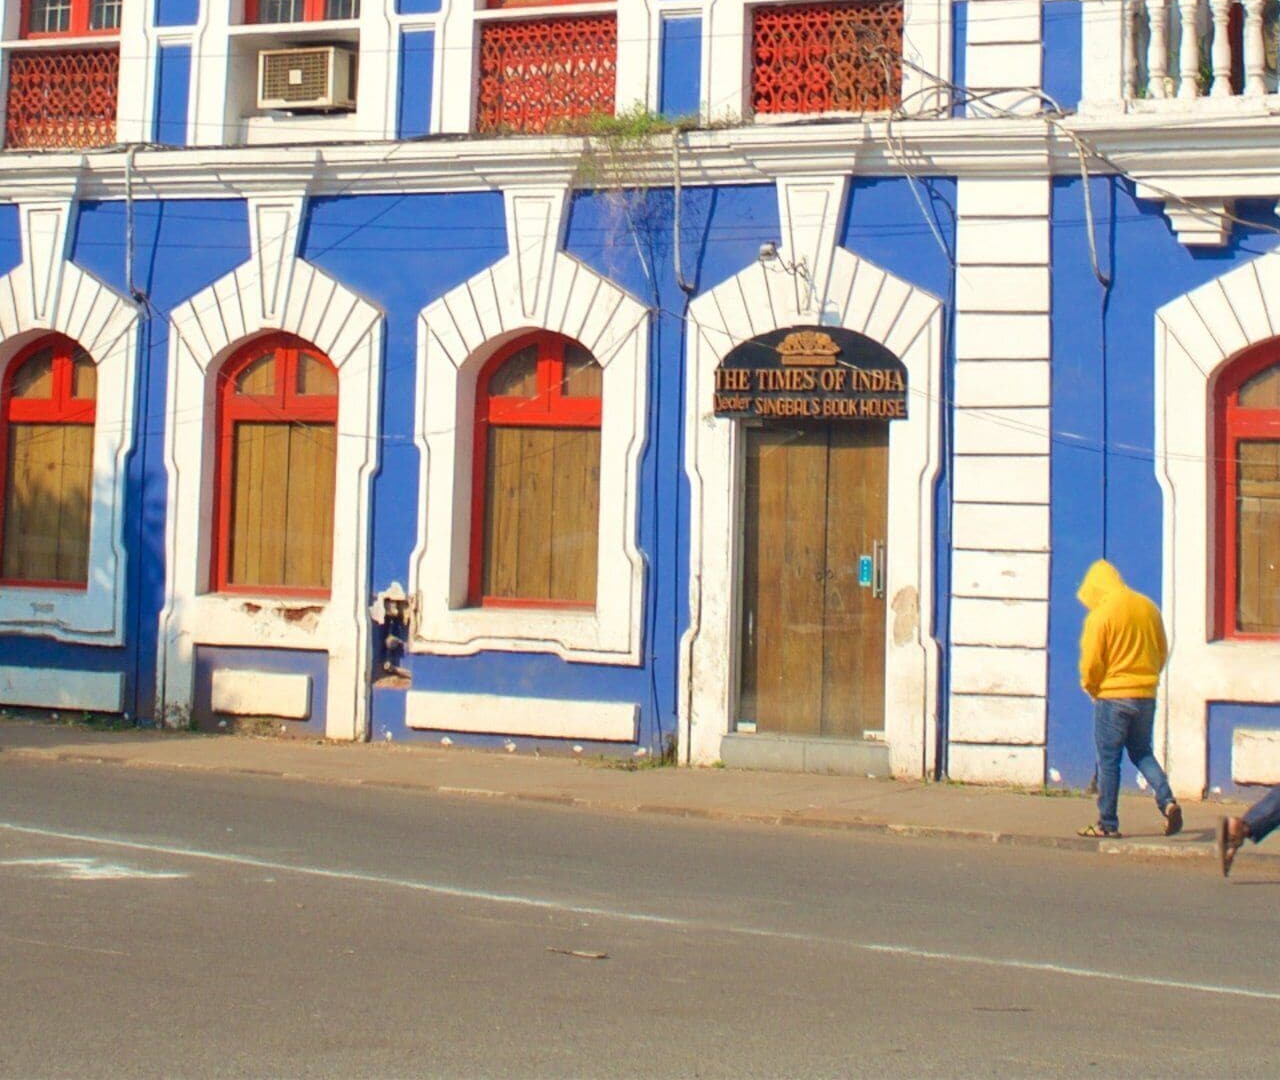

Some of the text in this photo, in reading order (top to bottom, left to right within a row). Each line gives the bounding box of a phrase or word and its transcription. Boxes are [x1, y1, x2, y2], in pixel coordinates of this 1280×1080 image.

[714, 367, 906, 391] THE TIMES OF INDIA
[823, 398, 857, 416] BOOK
[860, 398, 906, 416] HOUSE
